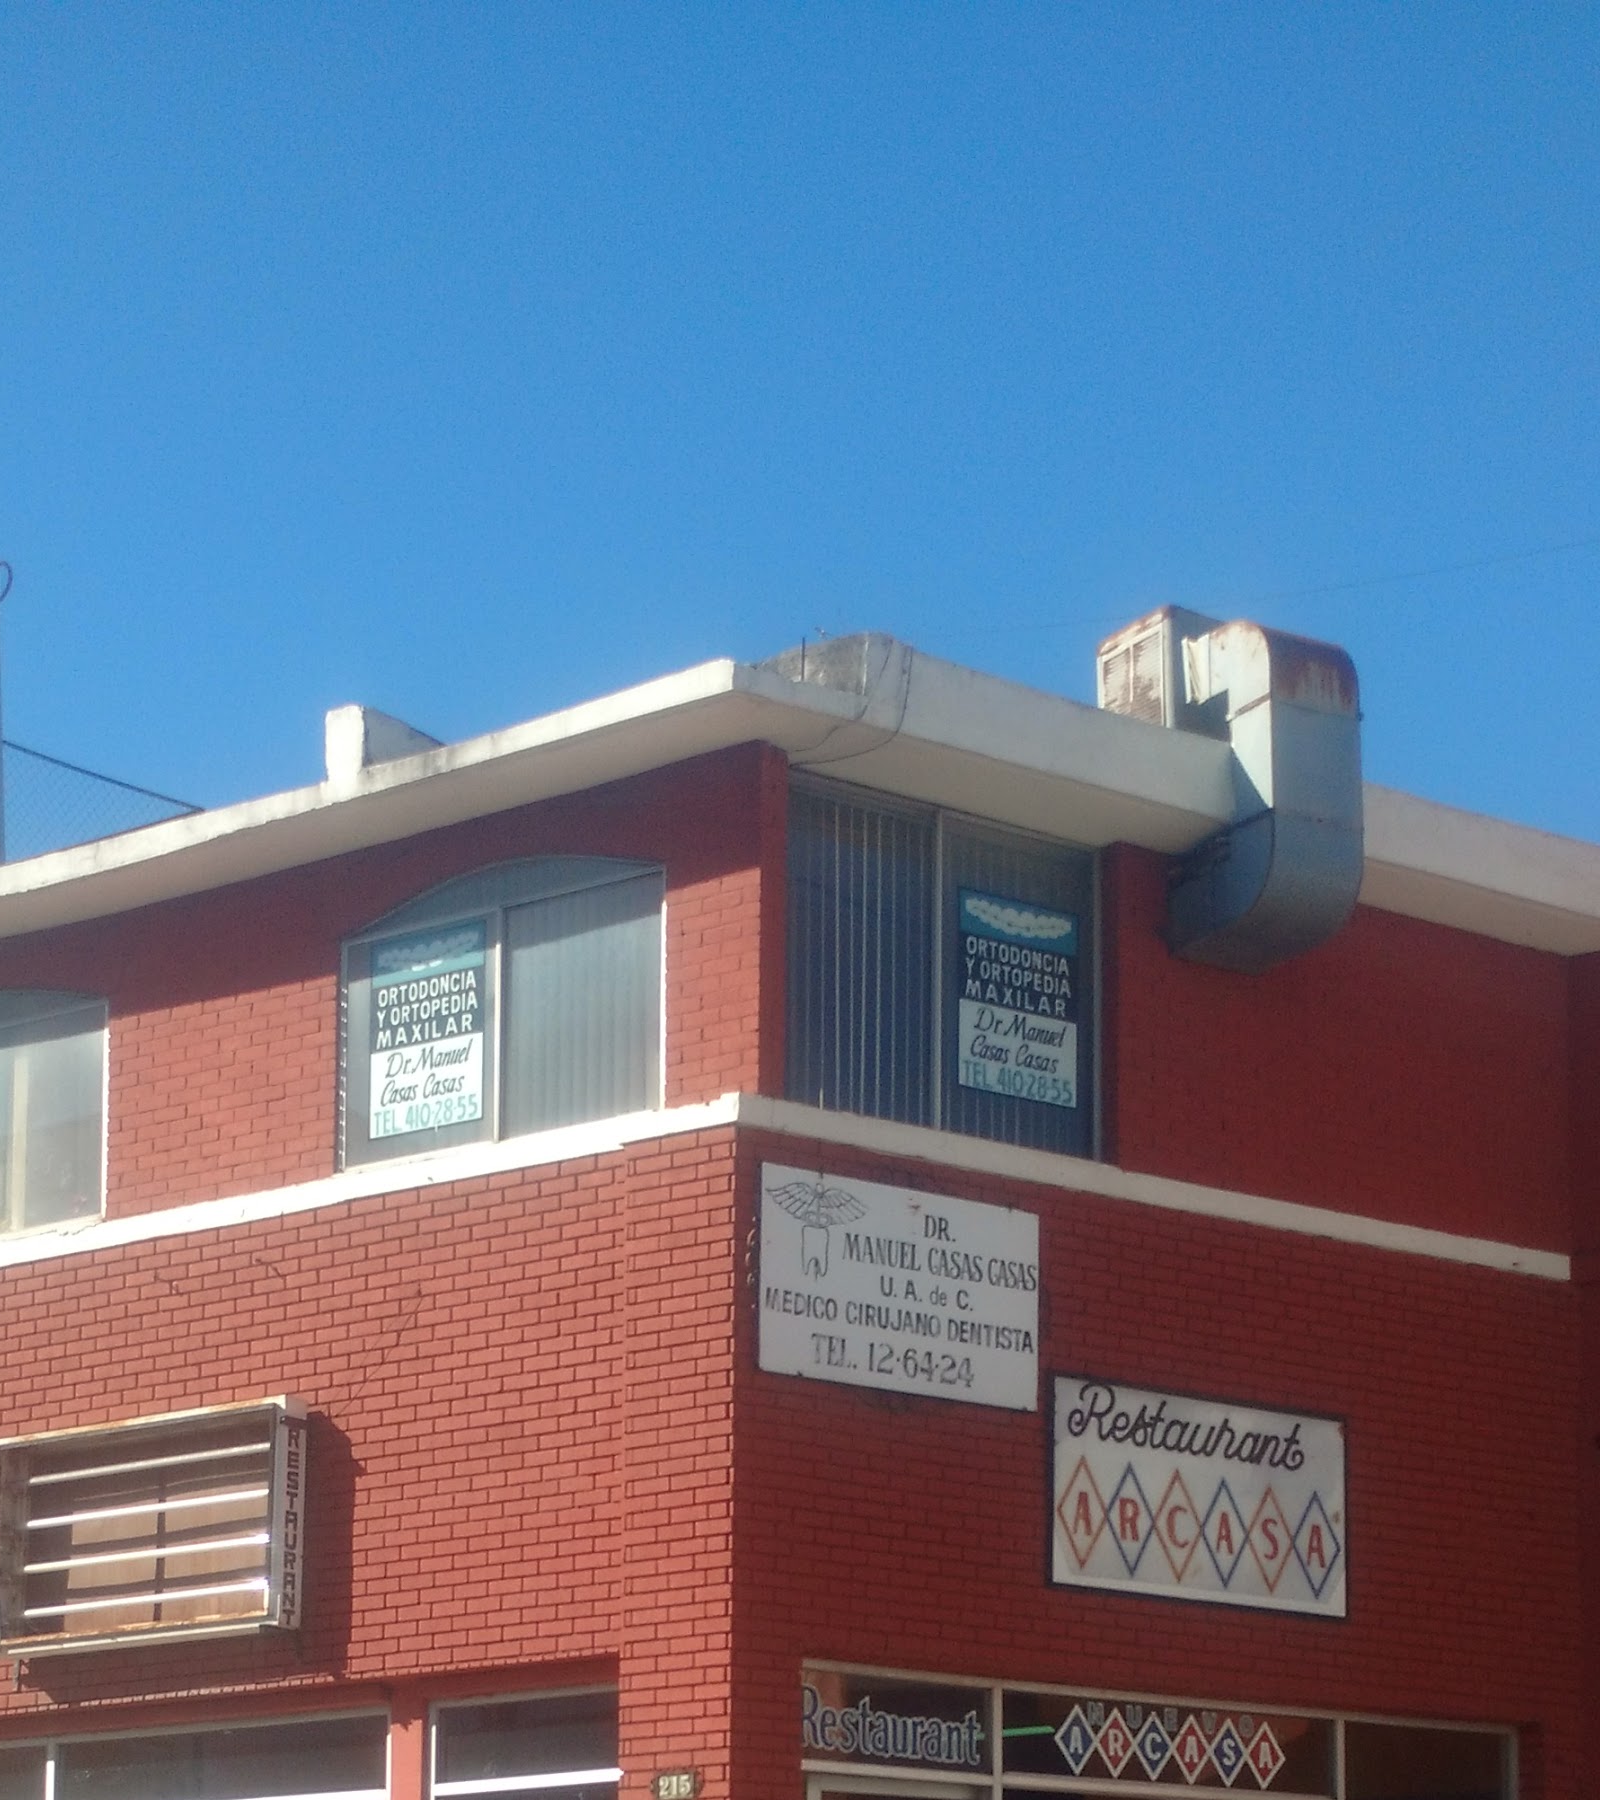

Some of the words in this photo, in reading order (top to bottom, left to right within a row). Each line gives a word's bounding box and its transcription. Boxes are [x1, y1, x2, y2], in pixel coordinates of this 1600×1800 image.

[965, 935, 1069, 977] ORTODONCIA
[378, 970, 477, 1008] ORTODONCIA
[965, 957, 976, 977] Y
[979, 961, 1071, 998] ORTOPEDIA
[376, 1010, 387, 1028] Y
[390, 991, 478, 1027] ORTOPEDIA
[965, 978, 1066, 1018] MAXILAR
[376, 1014, 473, 1050] MAXILAR
[1003, 1014, 1067, 1049] Manuel
[411, 1038, 474, 1075] Manuel
[970, 1035, 1010, 1065] Casas
[1015, 1043, 1059, 1074] Casas
[380, 1079, 418, 1107] Casas
[423, 1072, 465, 1100] Casas
[923, 1214, 956, 1242] DR.
[842, 1232, 921, 1271] MANUEL
[928, 1247, 983, 1283] CASAS
[988, 1258, 1037, 1292] CASAS
[880, 1274, 897, 1299] U.
[904, 1280, 922, 1302] A.
[929, 1285, 948, 1307] de
[956, 1289, 974, 1312] C.
[765, 1286, 838, 1321] MEDICO
[845, 1301, 941, 1338] CIRUJANO
[947, 1318, 1034, 1354] DENTISTA
[811, 1332, 857, 1370] TEL.
[1067, 1380, 1305, 1471] Restaurant
[802, 1683, 981, 1766] Restaurant
[658, 1773, 691, 1800] 215
